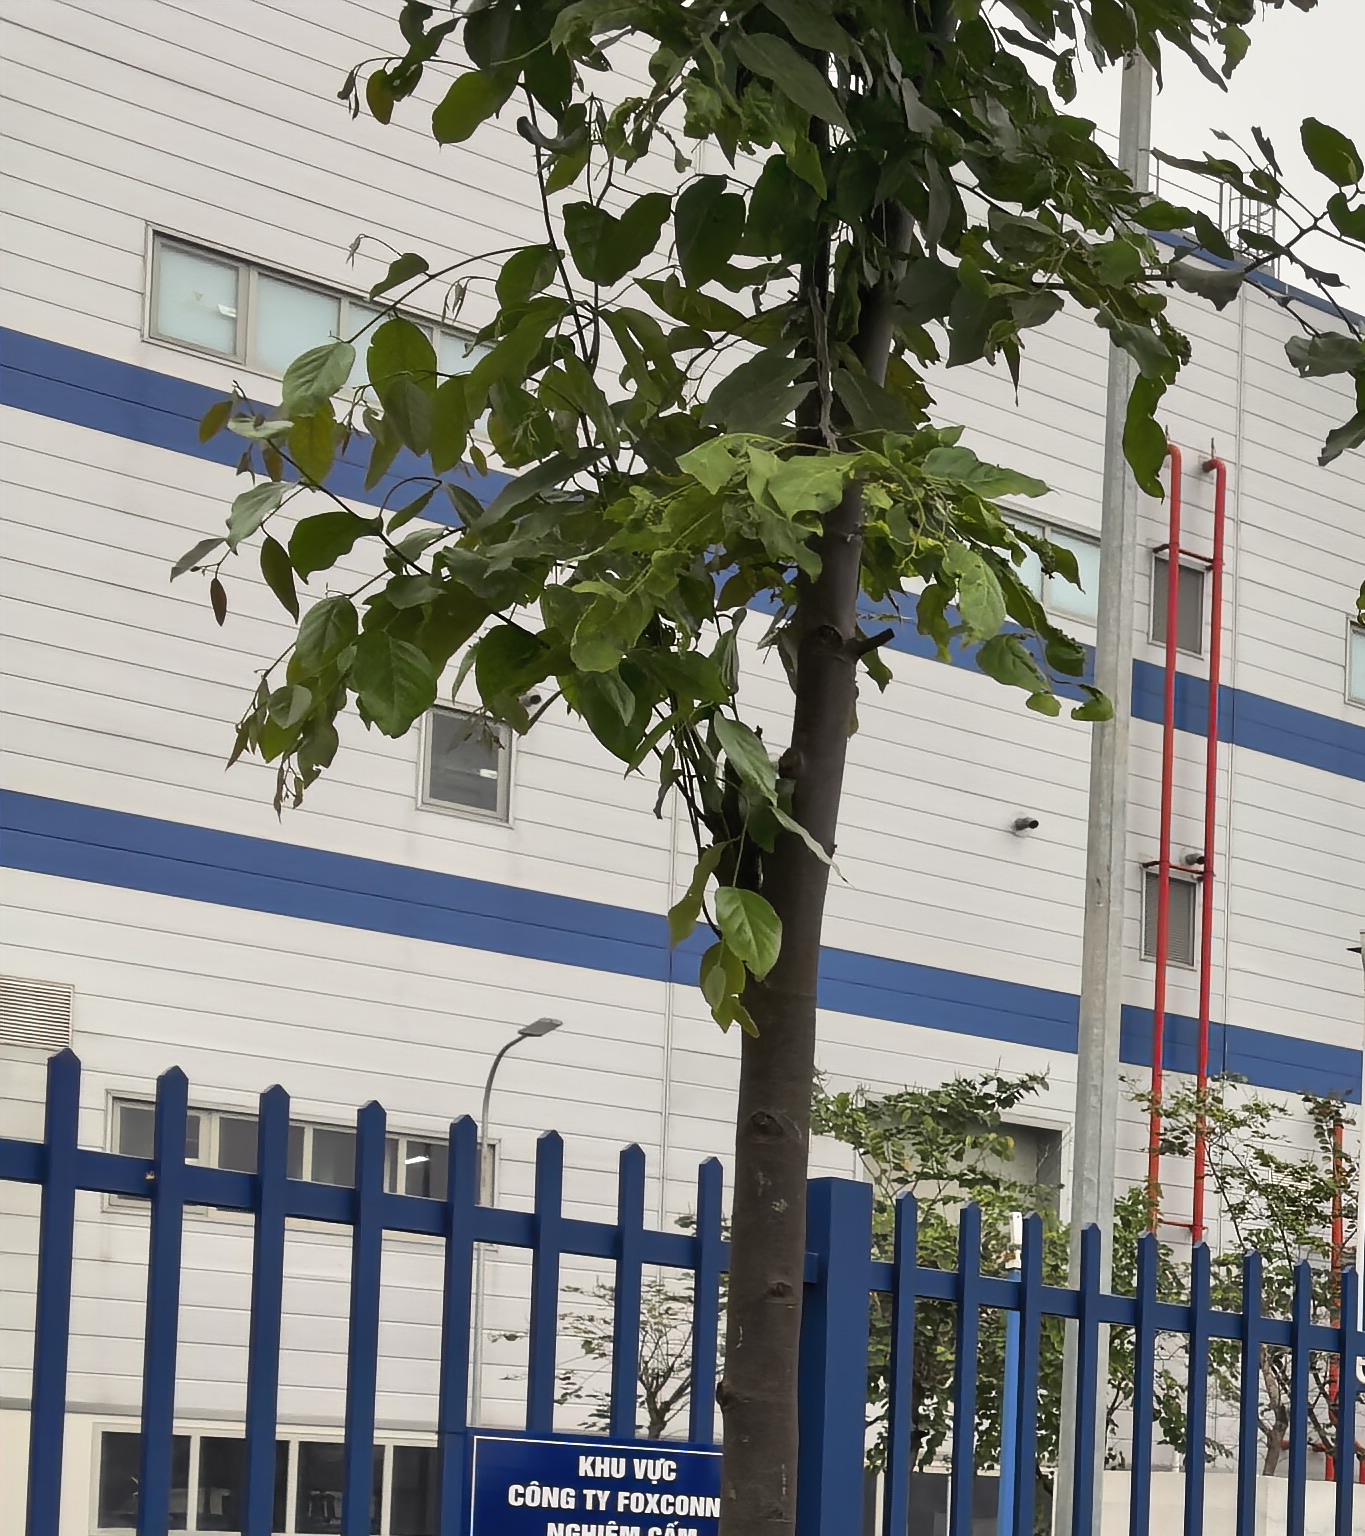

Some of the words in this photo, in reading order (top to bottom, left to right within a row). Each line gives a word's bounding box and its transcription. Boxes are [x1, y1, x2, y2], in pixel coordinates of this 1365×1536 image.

[578, 1455, 626, 1478] KHU
[633, 1458, 677, 1485] VỰC
[508, 1480, 576, 1510] CÔNG
[583, 1489, 611, 1511] TY
[617, 1491, 721, 1518] FOXCONN
